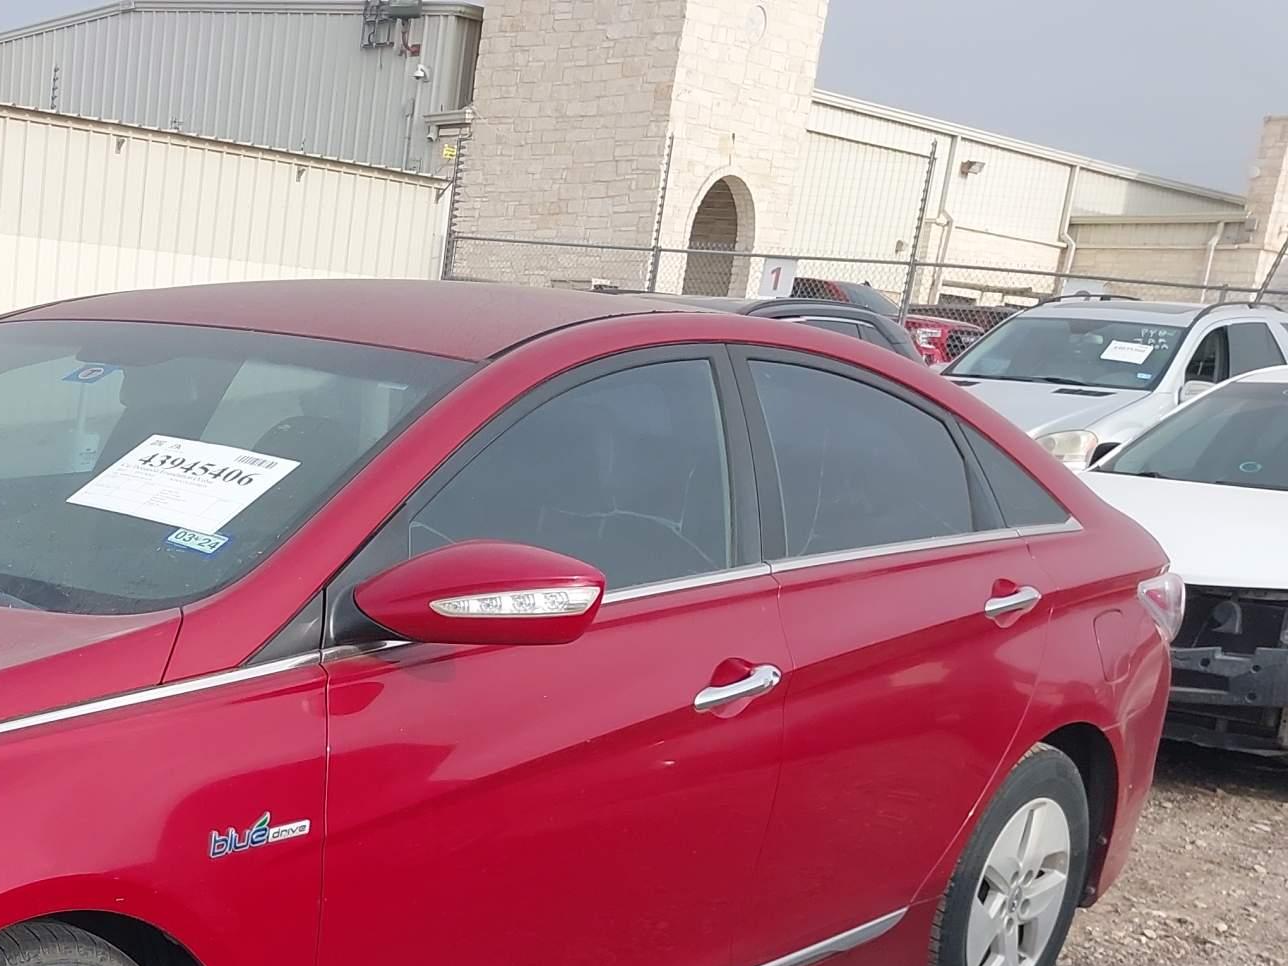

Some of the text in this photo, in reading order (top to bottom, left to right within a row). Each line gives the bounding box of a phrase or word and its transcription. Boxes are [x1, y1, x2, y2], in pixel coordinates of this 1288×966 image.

[770, 266, 782, 291] 1
[138, 452, 258, 487] 43945406
[210, 823, 308, 858] blue drive
